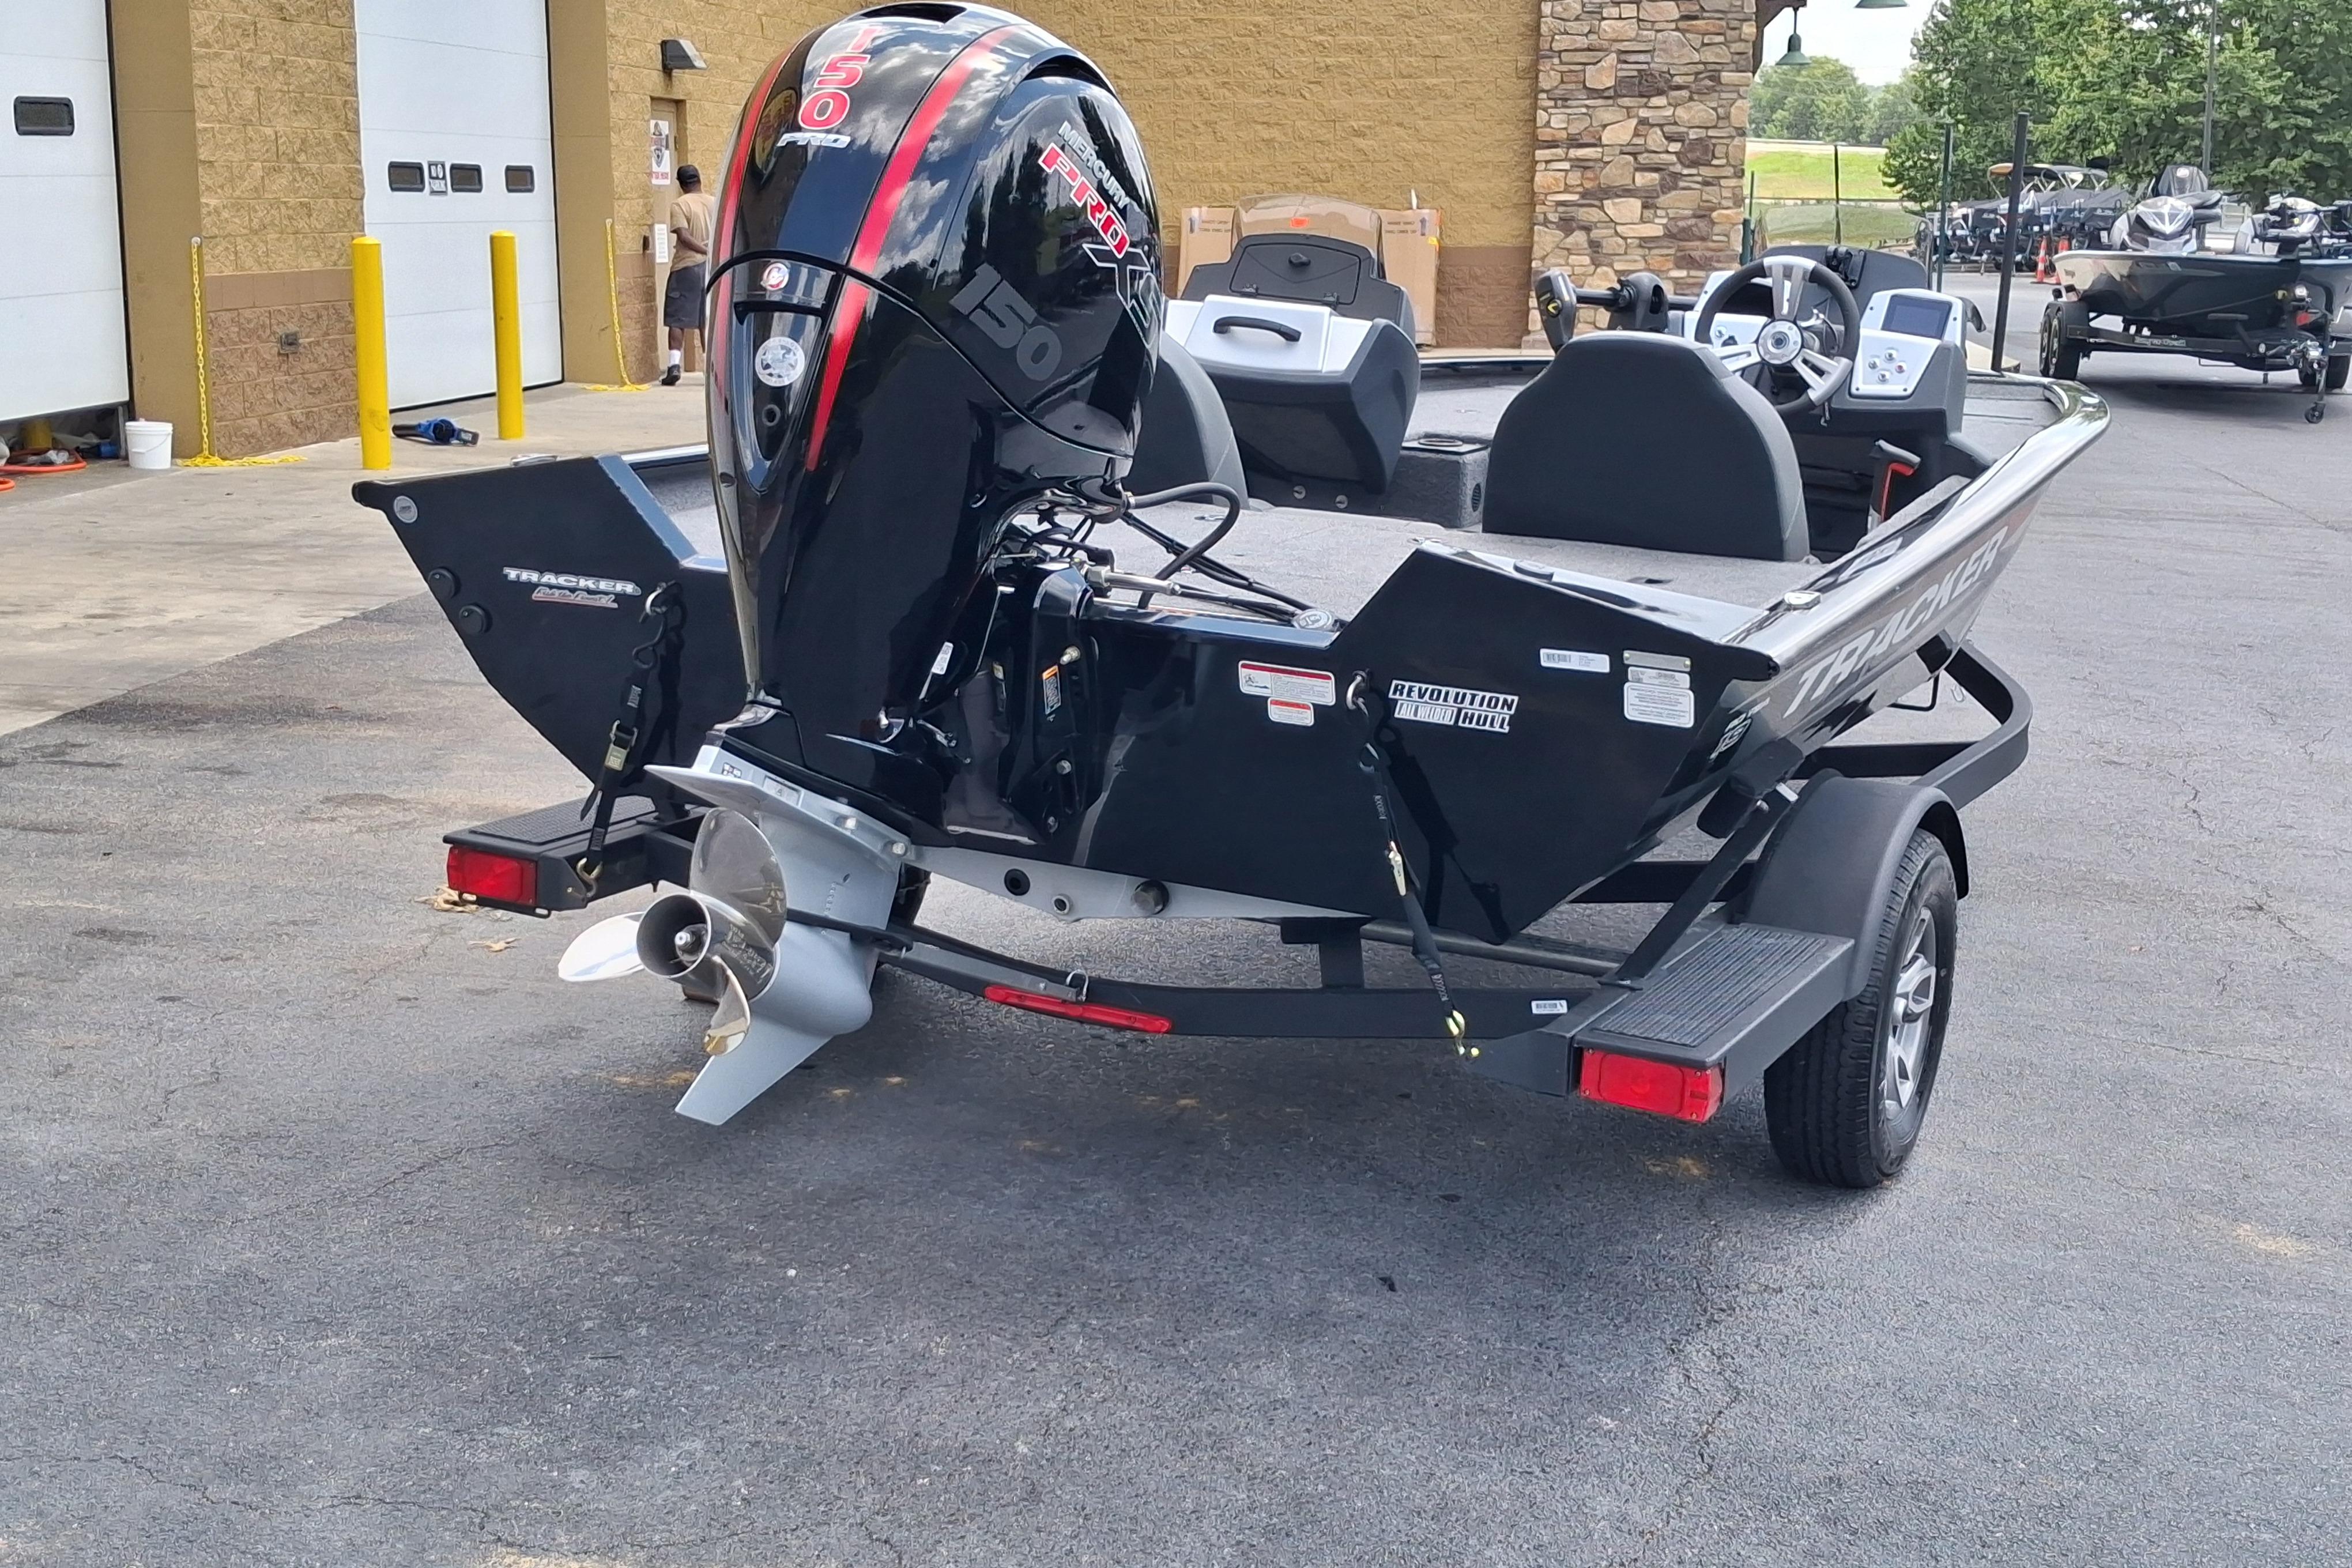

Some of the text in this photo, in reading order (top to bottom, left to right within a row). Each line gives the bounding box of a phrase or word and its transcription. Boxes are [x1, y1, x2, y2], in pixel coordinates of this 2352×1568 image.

[777, 132, 851, 148] PRO
[1058, 120, 1130, 209] MERCURY
[1038, 142, 1130, 258] PRO
[948, 262, 1062, 382] 150
[504, 568, 636, 594] TRACKER
[1783, 526, 2008, 719] TRACKER
[1391, 682, 1516, 712] REVOLUTION
[1460, 711, 1509, 731] HULL
